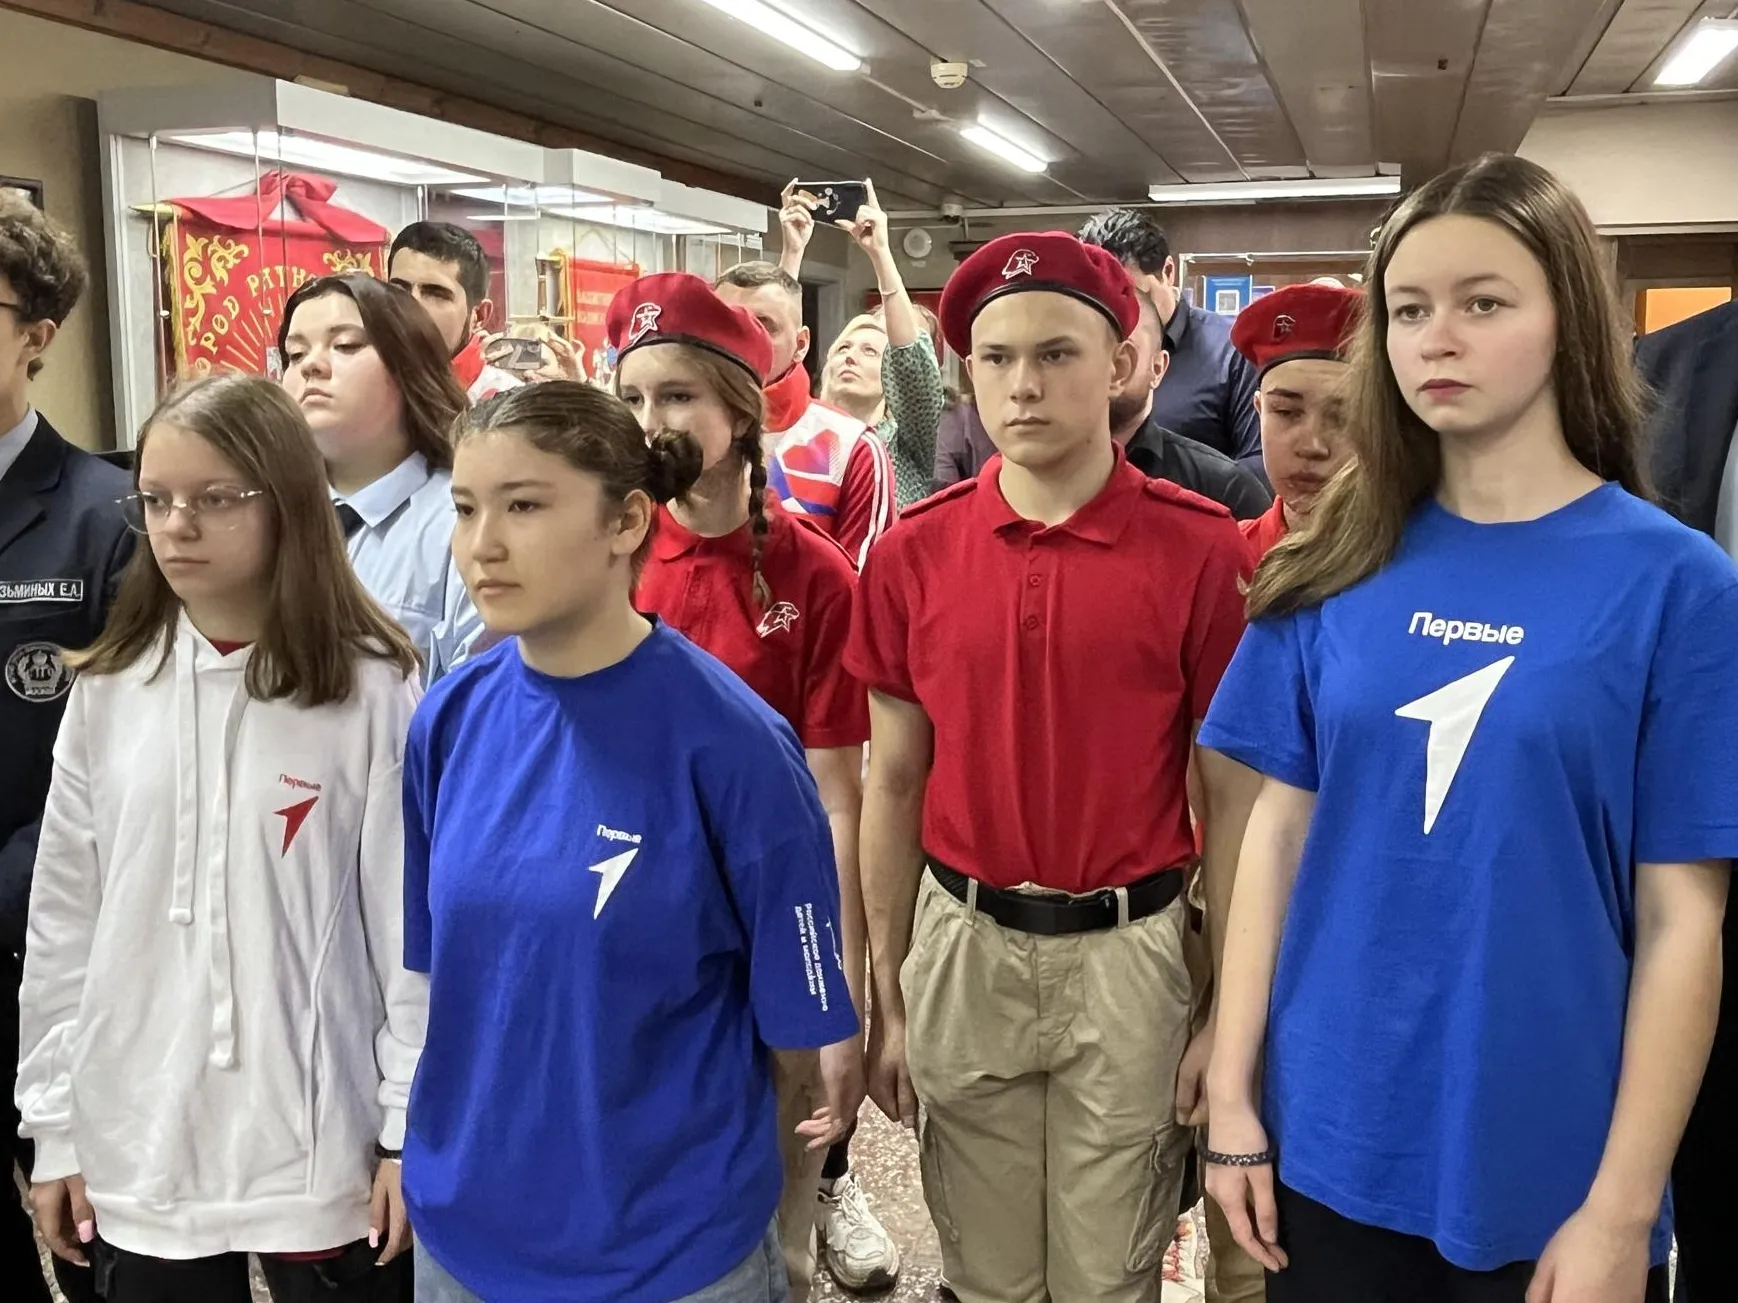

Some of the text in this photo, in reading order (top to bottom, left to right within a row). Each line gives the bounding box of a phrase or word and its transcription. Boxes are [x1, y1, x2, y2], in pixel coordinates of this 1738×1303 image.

[246, 265, 316, 297] РАТН
[1408, 611, 1524, 645] Первые
[279, 773, 321, 791] Первые
[597, 824, 642, 843] Первые
